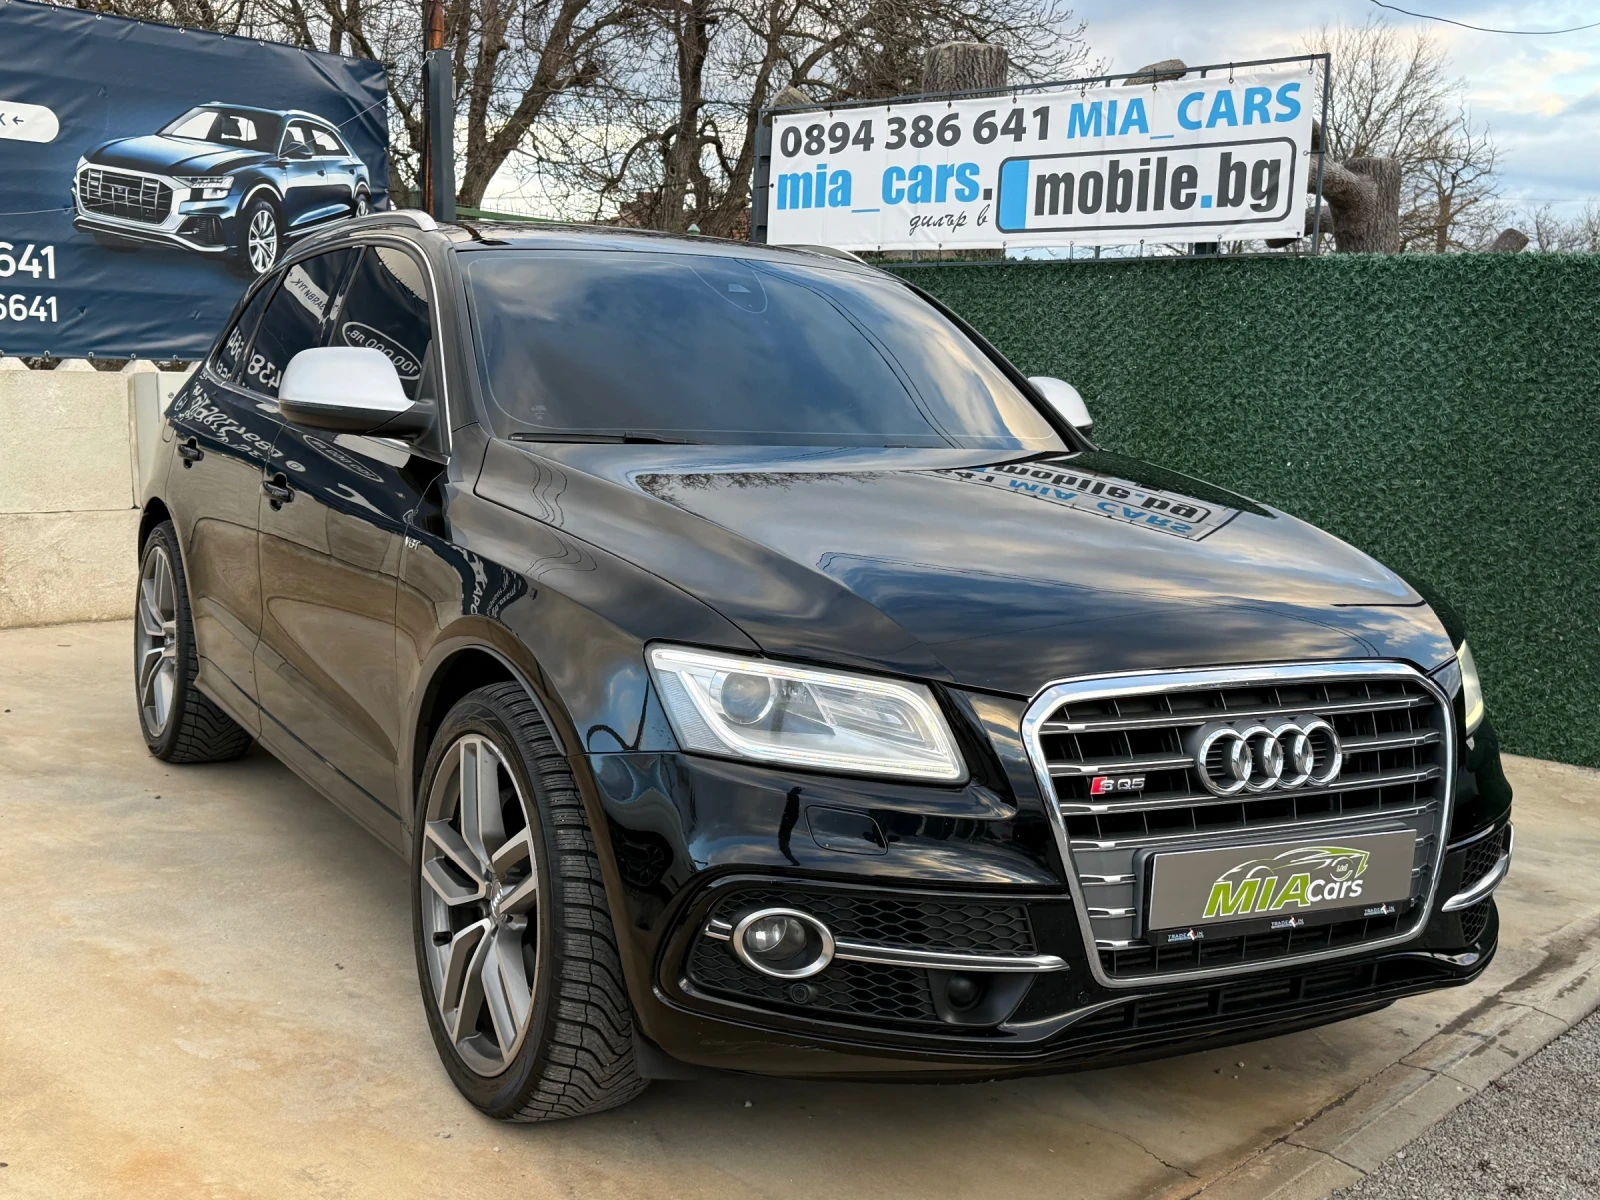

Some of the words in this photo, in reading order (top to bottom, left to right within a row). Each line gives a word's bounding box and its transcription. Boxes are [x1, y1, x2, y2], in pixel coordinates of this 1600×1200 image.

[780, 119, 875, 158] 0894
[884, 112, 962, 150] 386
[972, 106, 1050, 145] 641
[1066, 82, 1301, 140] MIA_CARS
[1034, 151, 1282, 217] mobile.bg
[908, 210, 968, 236] дилър
